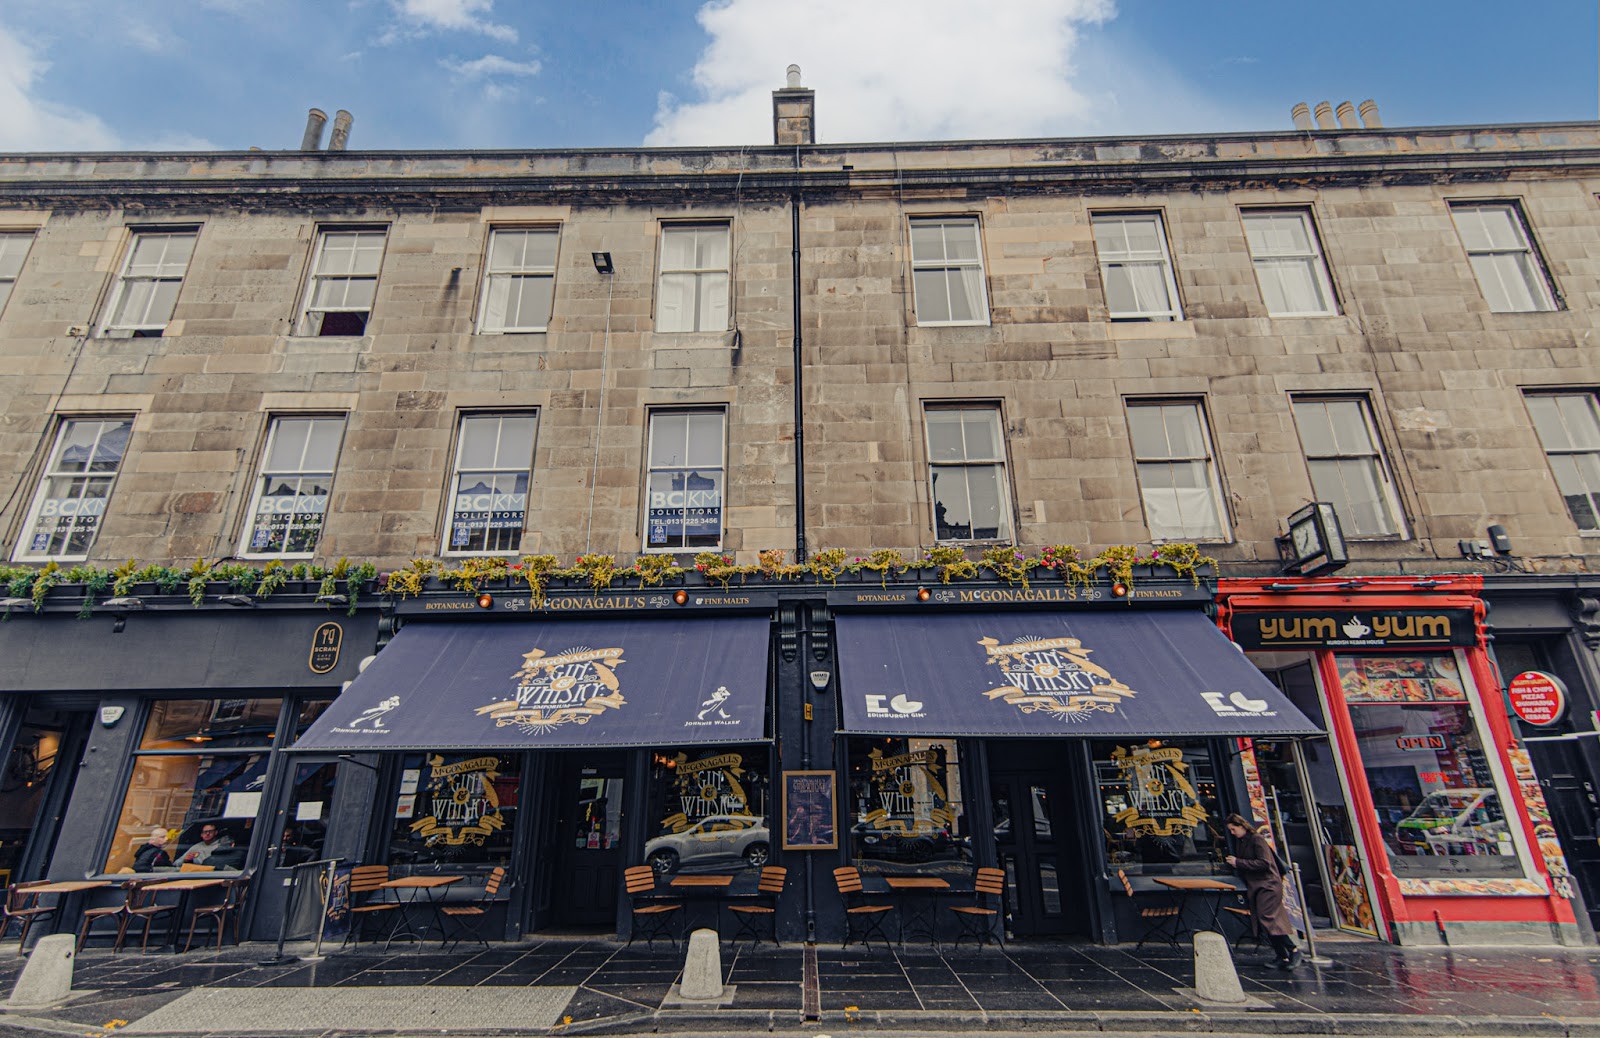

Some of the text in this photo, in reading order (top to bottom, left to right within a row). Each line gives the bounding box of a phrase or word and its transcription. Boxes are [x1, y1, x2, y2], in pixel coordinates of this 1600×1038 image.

[457, 494, 526, 511] BCKM
[652, 491, 718, 508] BCKM
[696, 597, 704, 605] &
[723, 597, 749, 605] MALTS
[857, 594, 906, 602] BOTANICALS
[1136, 590, 1154, 598] FINE
[425, 602, 475, 610] BOTANICALS
[1259, 615, 1451, 639] yum yum
[1022, 651, 1065, 669] GIN
[550, 661, 592, 681] GIN
[1004, 671, 1097, 691] WHISKY
[515, 682, 605, 705] WHISKY
[1396, 736, 1443, 749] OPEN
[451, 773, 476, 794] GIN
[698, 770, 722, 791] GIN
[895, 766, 912, 785] GI
[432, 798, 489, 820] WHISKY
[680, 795, 737, 817] WHISKY
[1127, 789, 1187, 811] WHISKY
